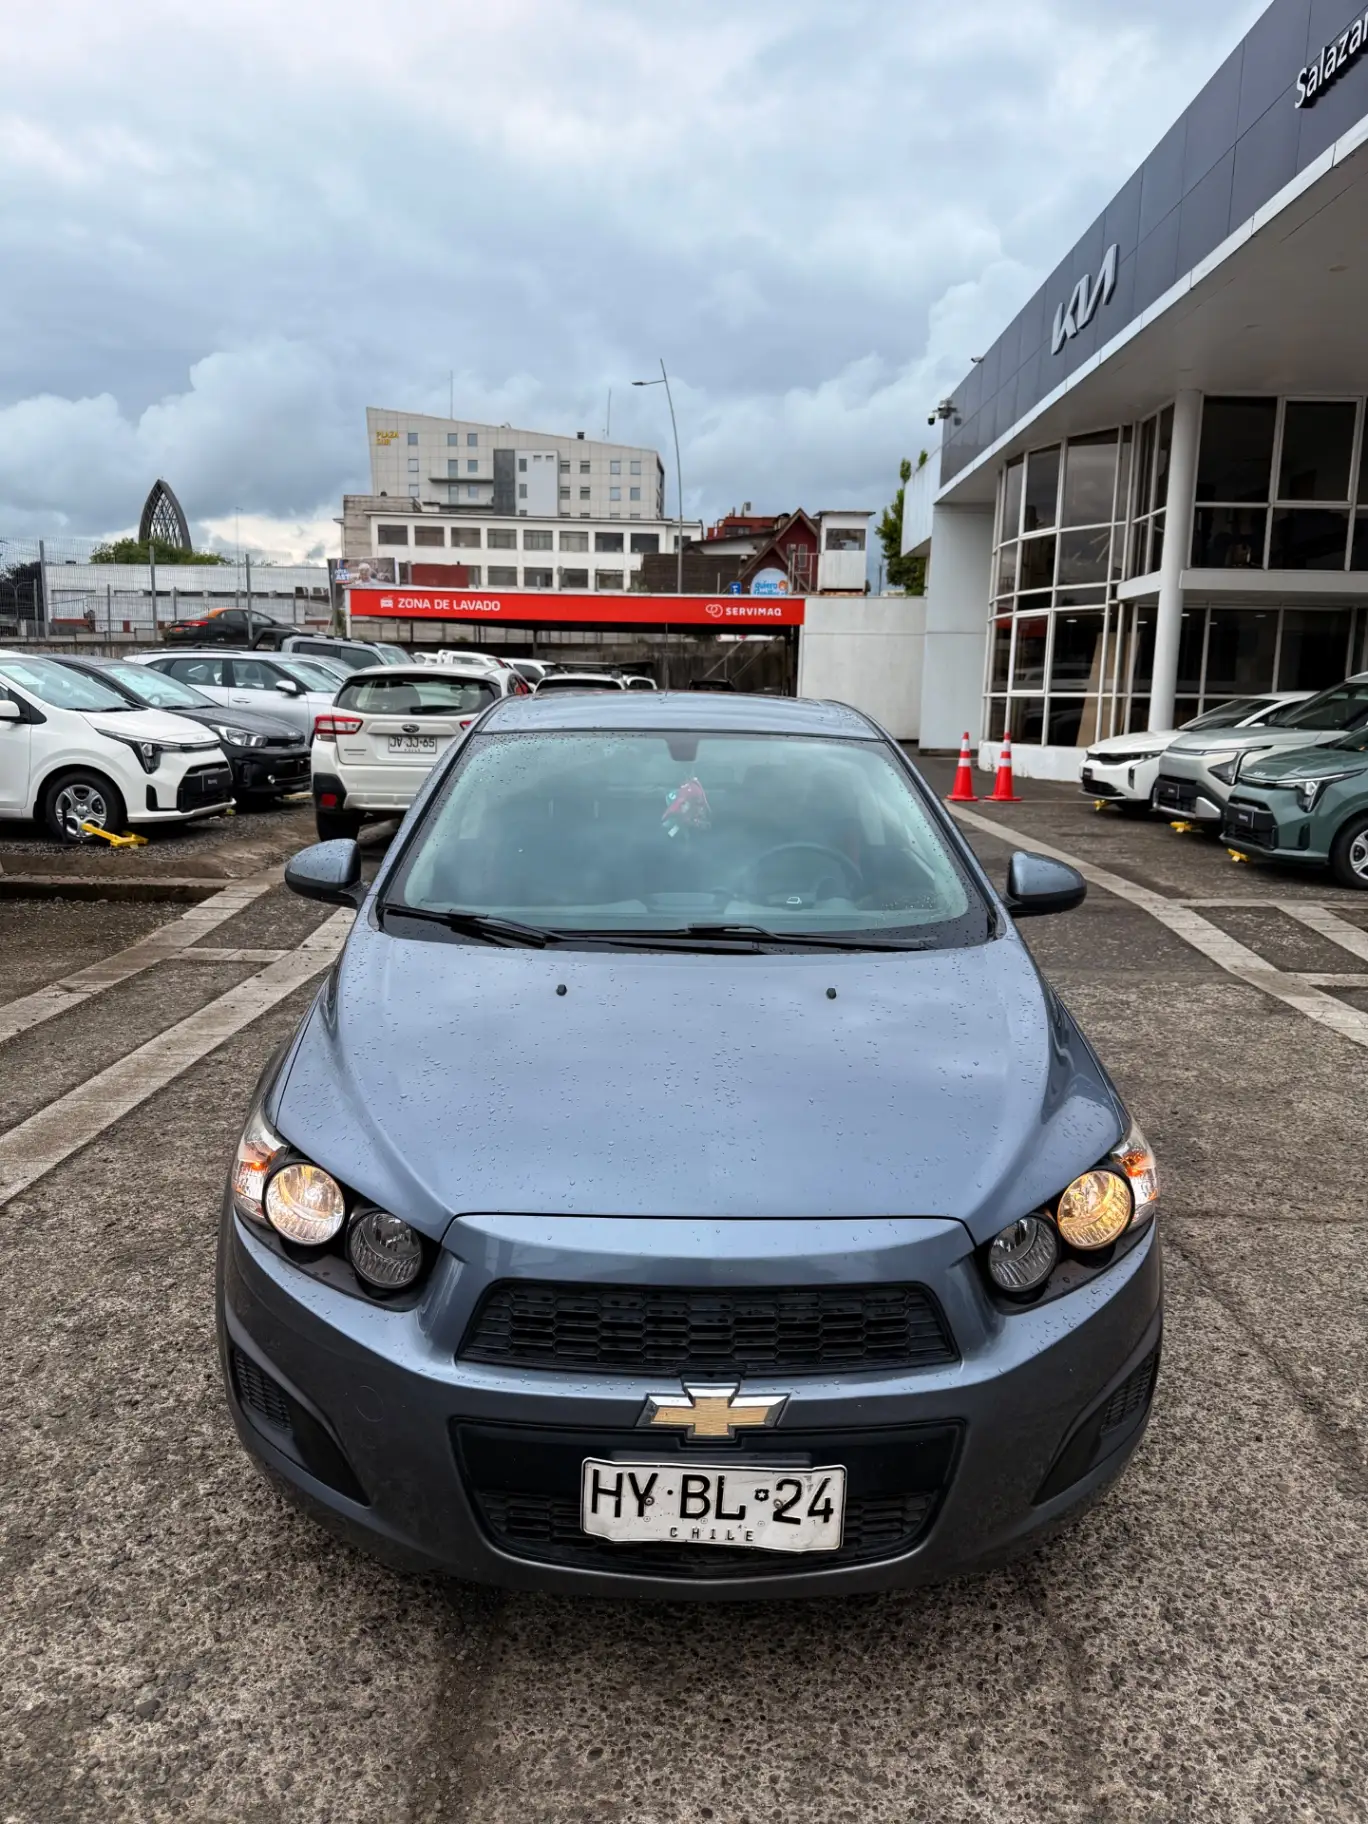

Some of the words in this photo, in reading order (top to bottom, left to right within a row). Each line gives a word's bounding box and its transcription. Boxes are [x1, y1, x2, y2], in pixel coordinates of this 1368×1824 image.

[397, 597, 431, 609] ZONA
[433, 598, 450, 610] DE
[452, 599, 501, 612] LAVADO
[725, 607, 782, 617] SERVIMAQ
[669, 1526, 755, 1542] CHILE
